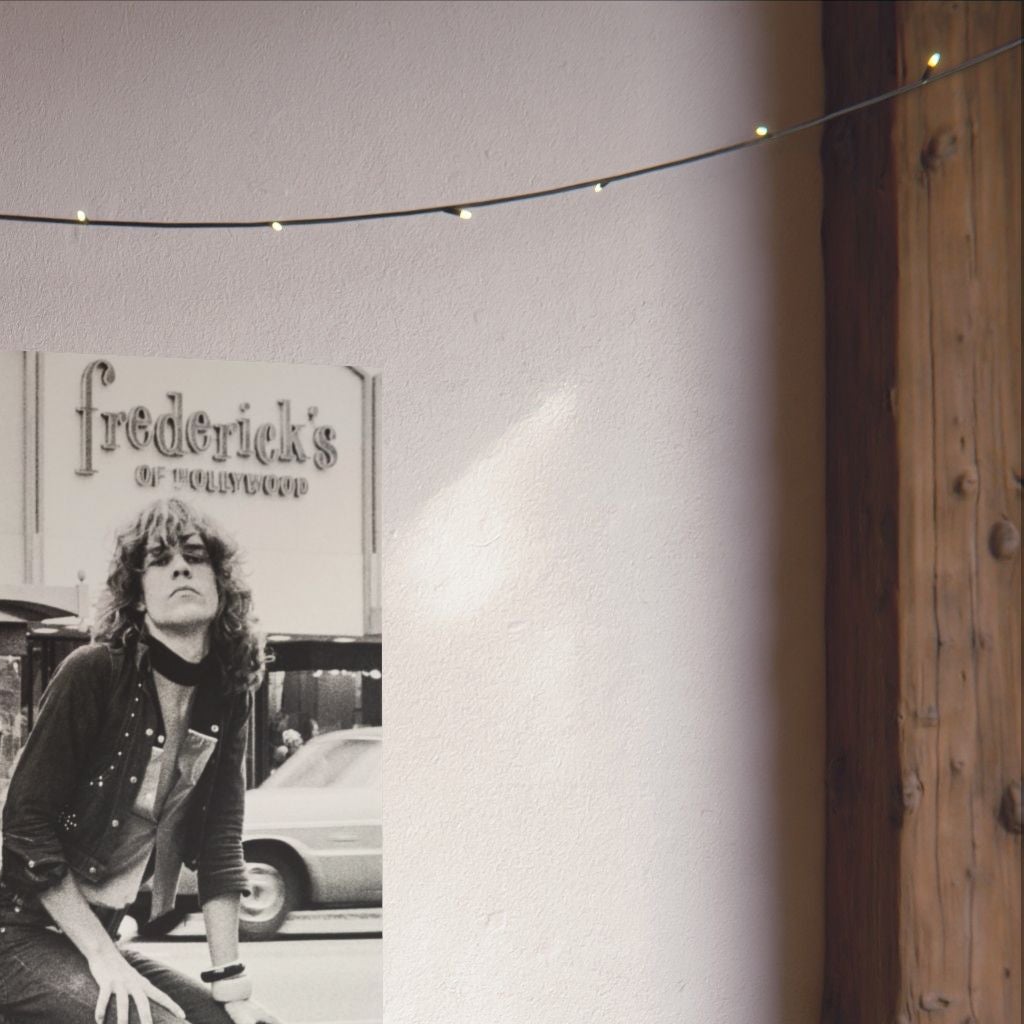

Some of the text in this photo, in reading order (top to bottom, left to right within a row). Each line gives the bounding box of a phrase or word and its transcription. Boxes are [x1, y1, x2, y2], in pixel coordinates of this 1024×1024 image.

[74, 359, 338, 476] frederick's
[134, 464, 309, 498] OF HOLLYWOOD
